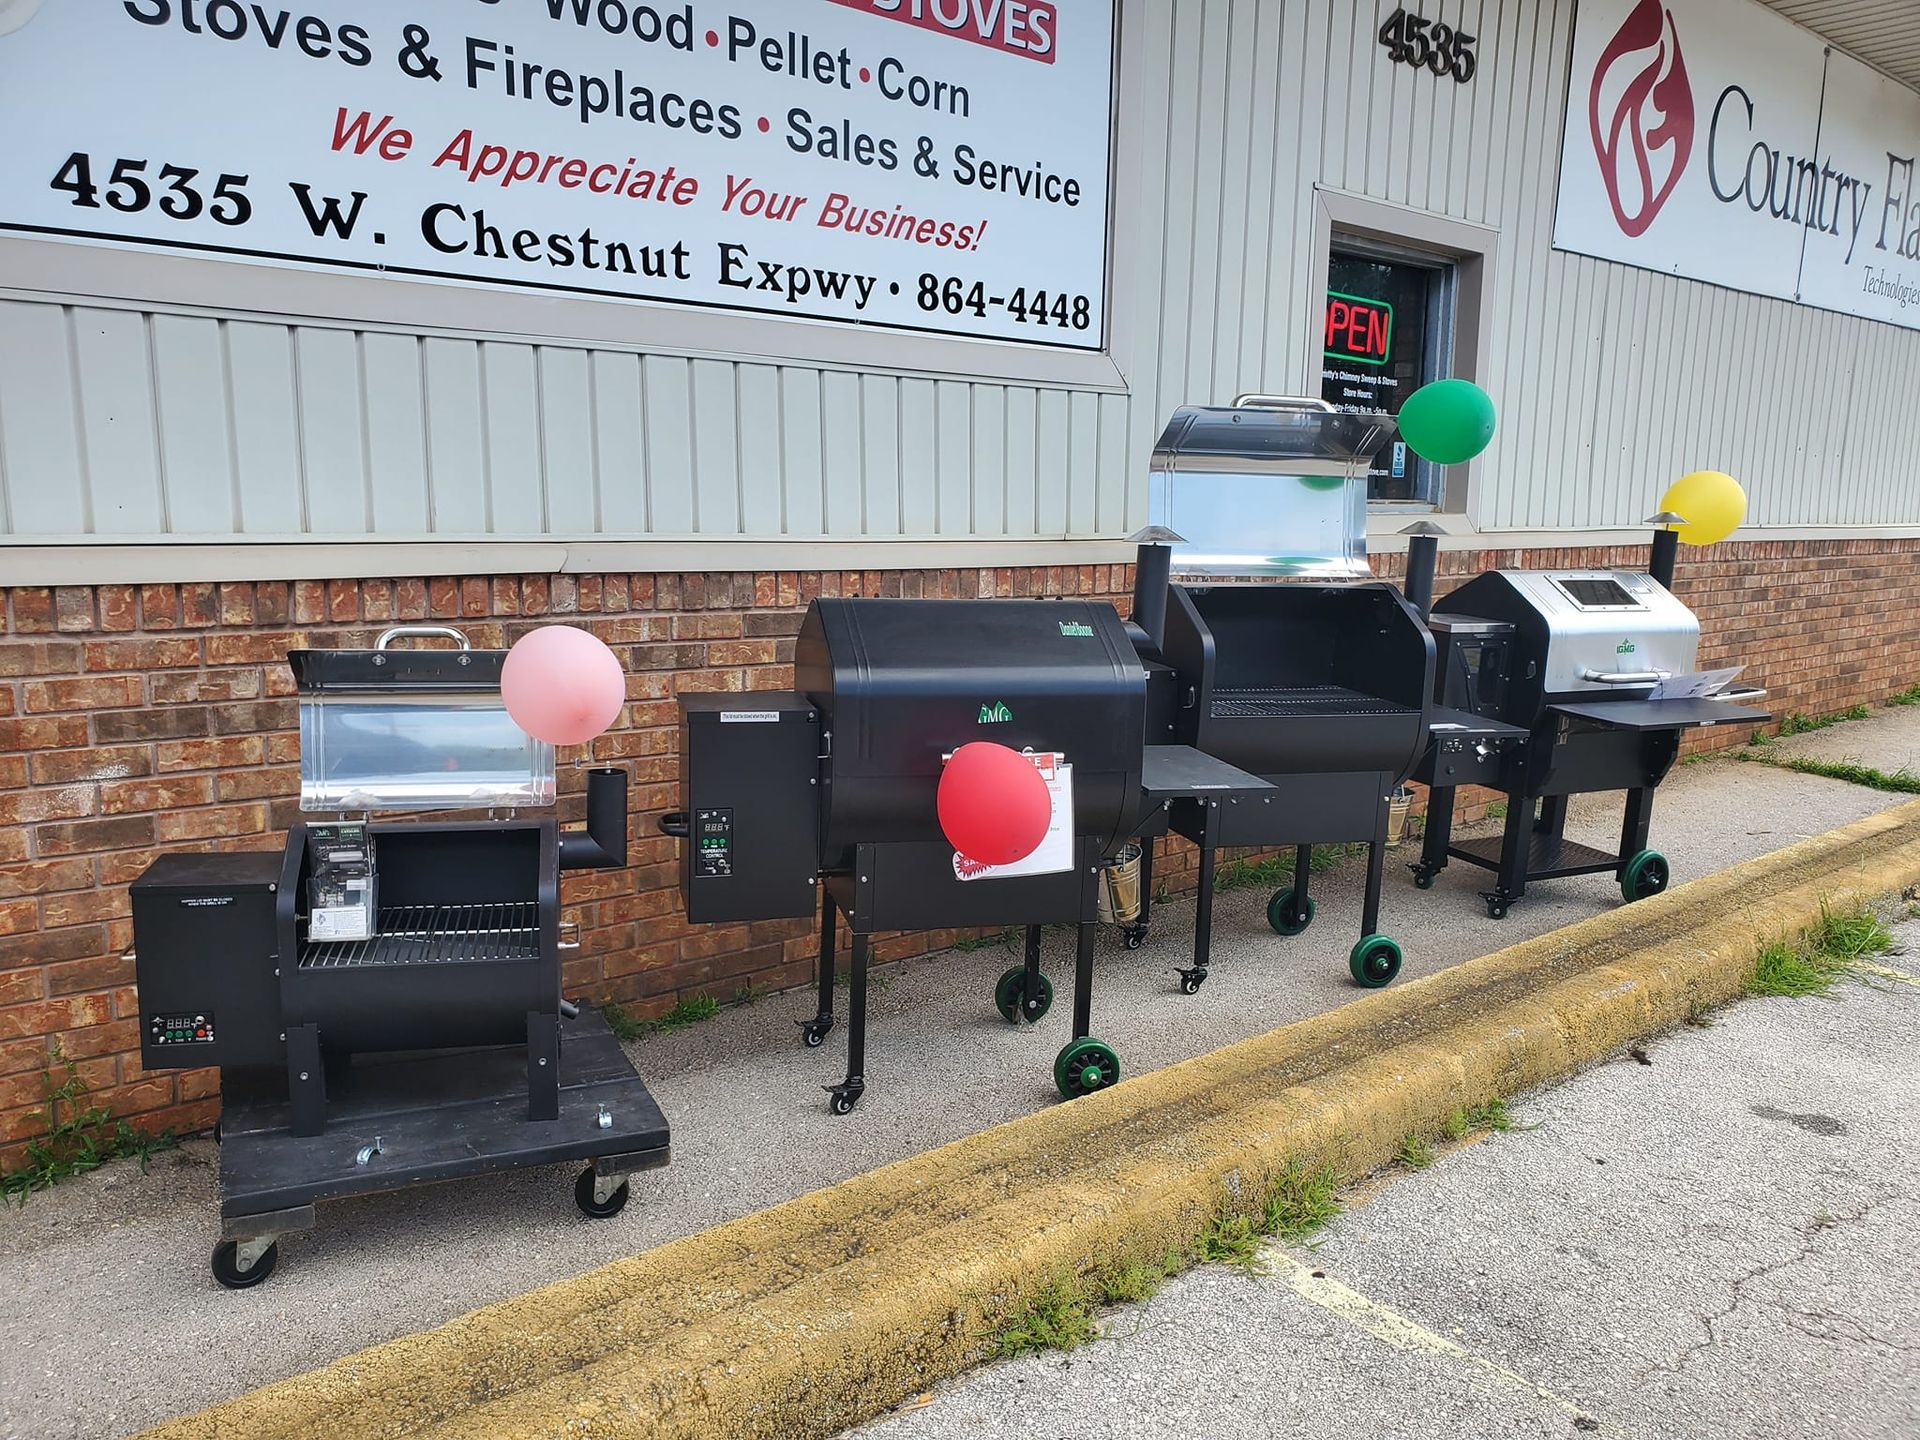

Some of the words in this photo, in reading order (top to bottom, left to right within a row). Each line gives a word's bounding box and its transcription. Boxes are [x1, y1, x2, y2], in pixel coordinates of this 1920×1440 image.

[728, 15, 851, 90] Pellet
[878, 57, 970, 118] Corn
[872, 0, 1053, 54] OVES
[1378, 8, 1477, 84] 4535
[398, 23, 443, 83] &
[465, 36, 742, 140] Fireplaces
[786, 107, 898, 170] Sales
[913, 135, 940, 180] &
[953, 144, 1081, 207] Service
[331, 107, 413, 161] We
[431, 129, 699, 206] Appreciate
[720, 174, 807, 222] Your
[816, 192, 988, 252] Business!
[1707, 84, 1872, 265] Country
[50, 152, 252, 226] 4535
[288, 182, 386, 245] W.
[420, 202, 692, 280] Chestnut
[717, 242, 877, 310] Expwy
[916, 273, 1090, 330] 864-4448
[1862, 265, 1920, 308] Technologies
[1324, 301, 1389, 355] PEN
